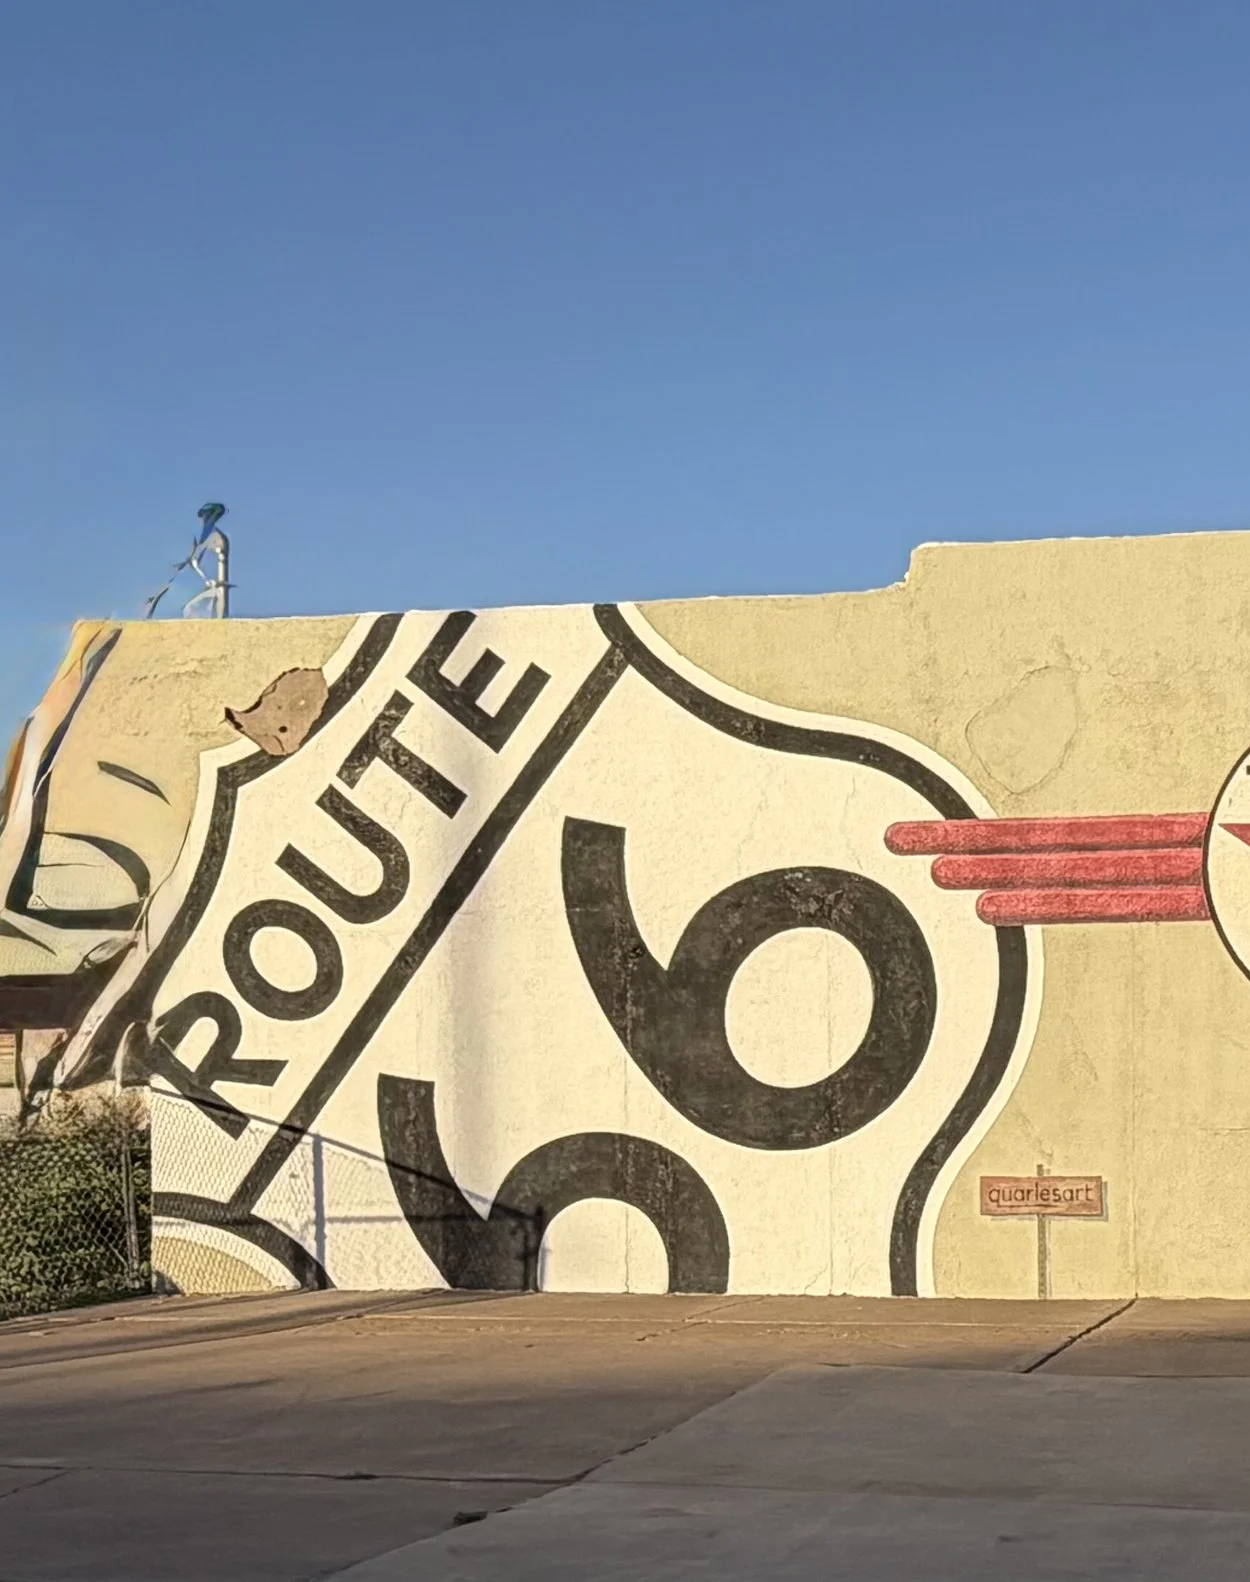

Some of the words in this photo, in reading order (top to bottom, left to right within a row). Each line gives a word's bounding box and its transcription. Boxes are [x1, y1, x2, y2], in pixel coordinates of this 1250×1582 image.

[153, 610, 552, 1140] ROUTE
[377, 815, 938, 1292] 66
[988, 1182, 1094, 1207] quarlesart
